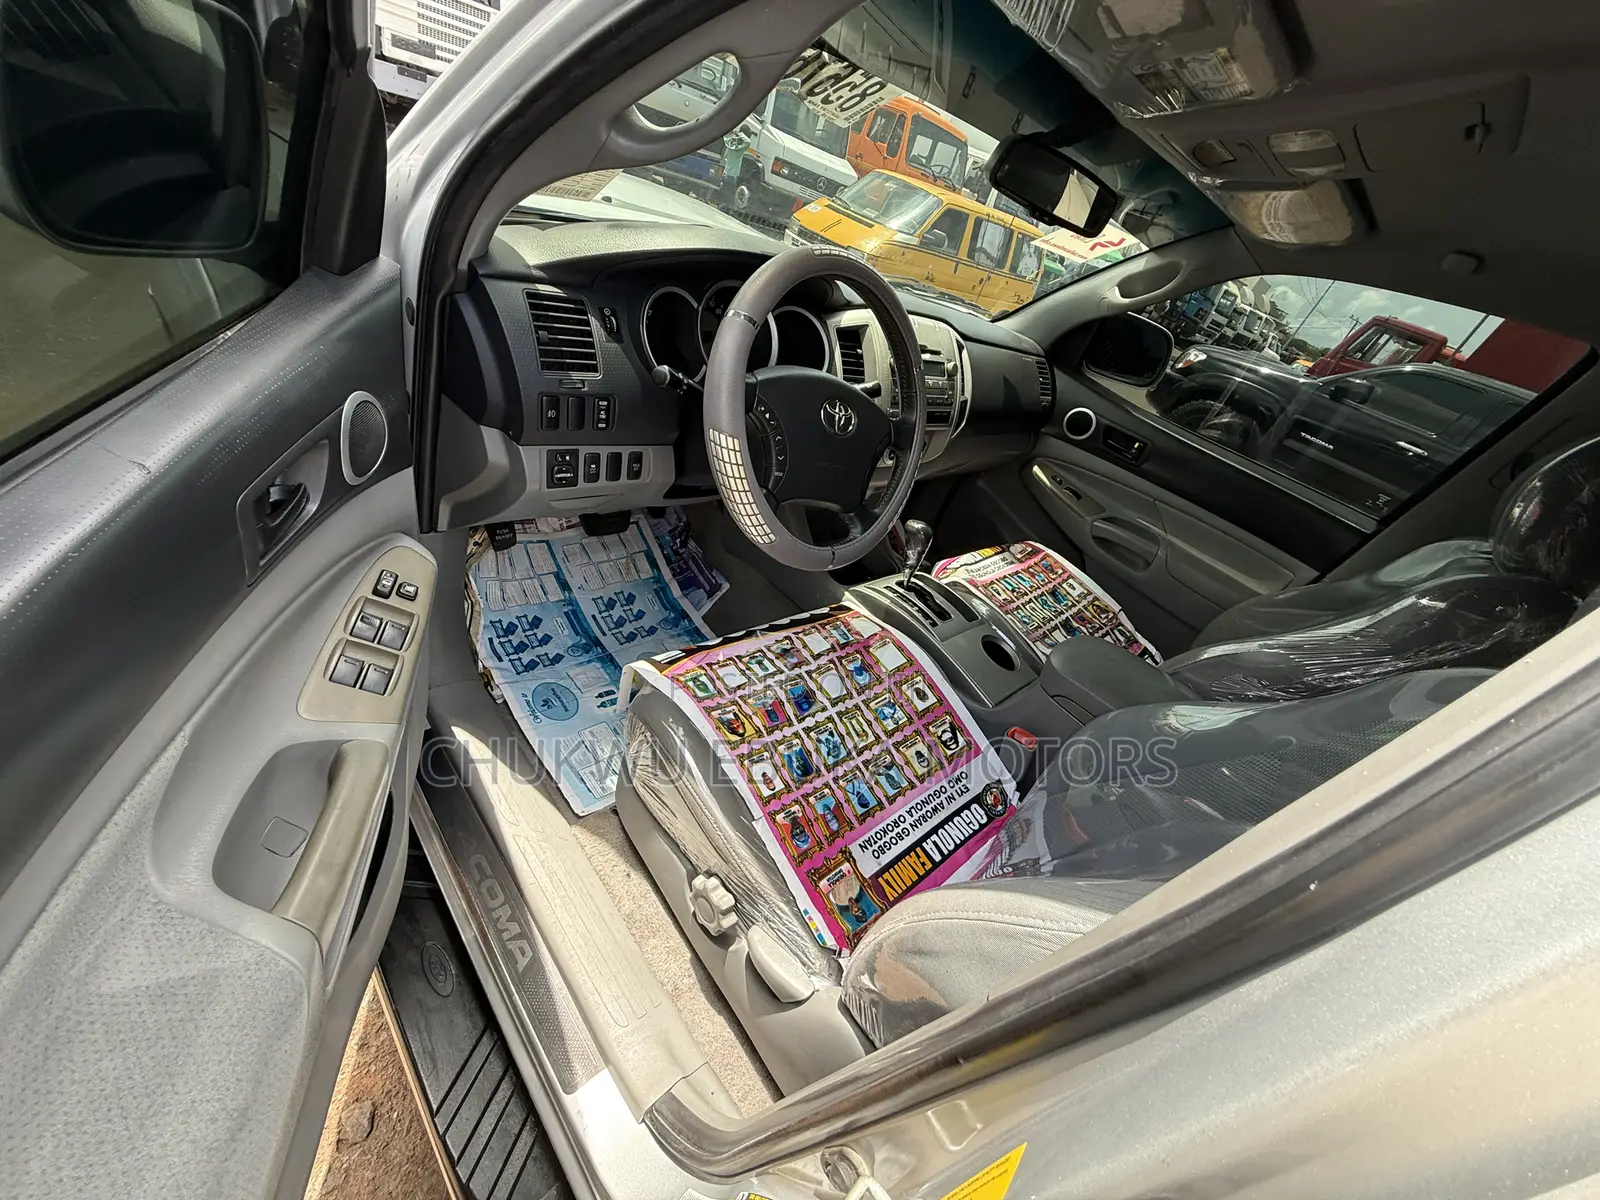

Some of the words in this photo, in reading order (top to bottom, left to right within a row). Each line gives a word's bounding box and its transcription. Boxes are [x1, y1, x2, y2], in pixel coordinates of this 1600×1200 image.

[946, 769, 968, 789] OMO
[954, 782, 970, 798] EYI
[905, 784, 948, 818] OGUNOLA
[908, 799, 946, 833] AWORAN
[943, 792, 956, 806] NI
[857, 812, 906, 852] OROKOTAN
[870, 826, 911, 860] GBOGBO
[921, 801, 988, 864] OGUNOLA
[876, 846, 932, 901] FAMILY
